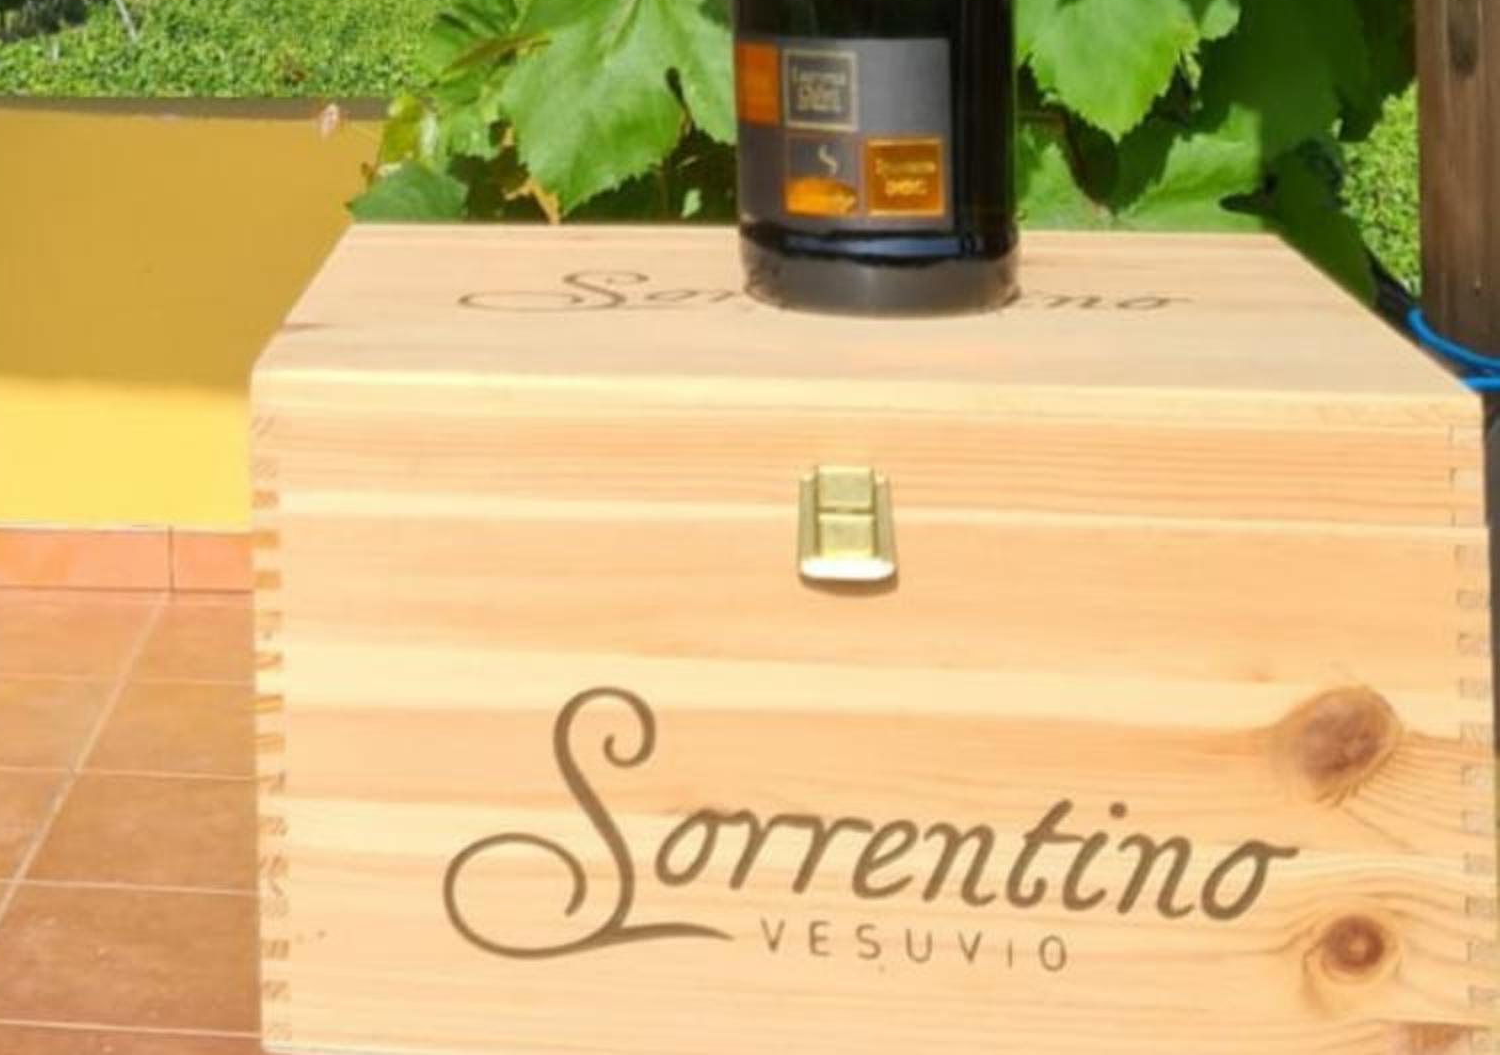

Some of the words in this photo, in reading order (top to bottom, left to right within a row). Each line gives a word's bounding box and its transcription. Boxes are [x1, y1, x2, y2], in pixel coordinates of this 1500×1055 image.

[457, 269, 1196, 314] Sorno
[442, 685, 1299, 960] Sorrentino
[759, 916, 1068, 973] VESUVIO
